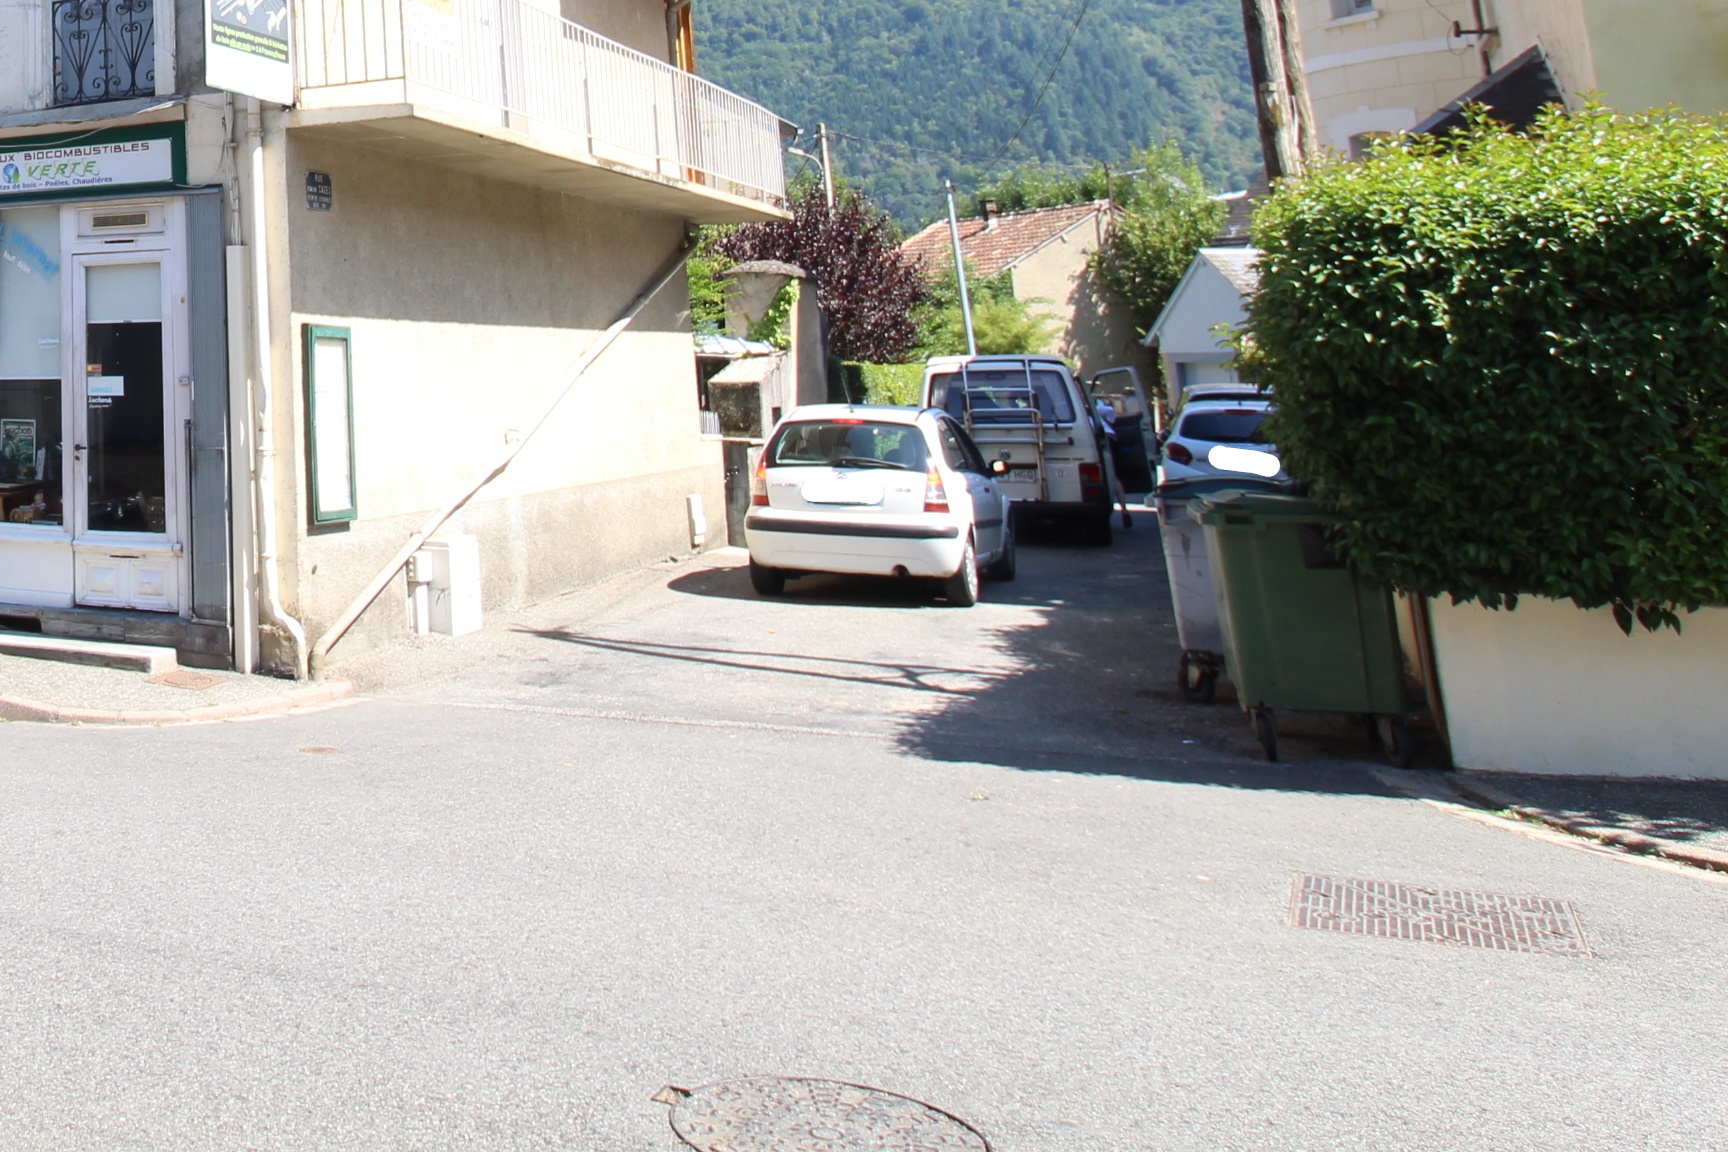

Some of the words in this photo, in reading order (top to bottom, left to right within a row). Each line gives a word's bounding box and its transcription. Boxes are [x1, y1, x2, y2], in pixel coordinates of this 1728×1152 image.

[24, 142, 150, 161] BIOCOMBUSTIBLES
[28, 160, 98, 178] VERTE
[22, 180, 36, 188] bois
[72, 176, 112, 185] Chaudières
